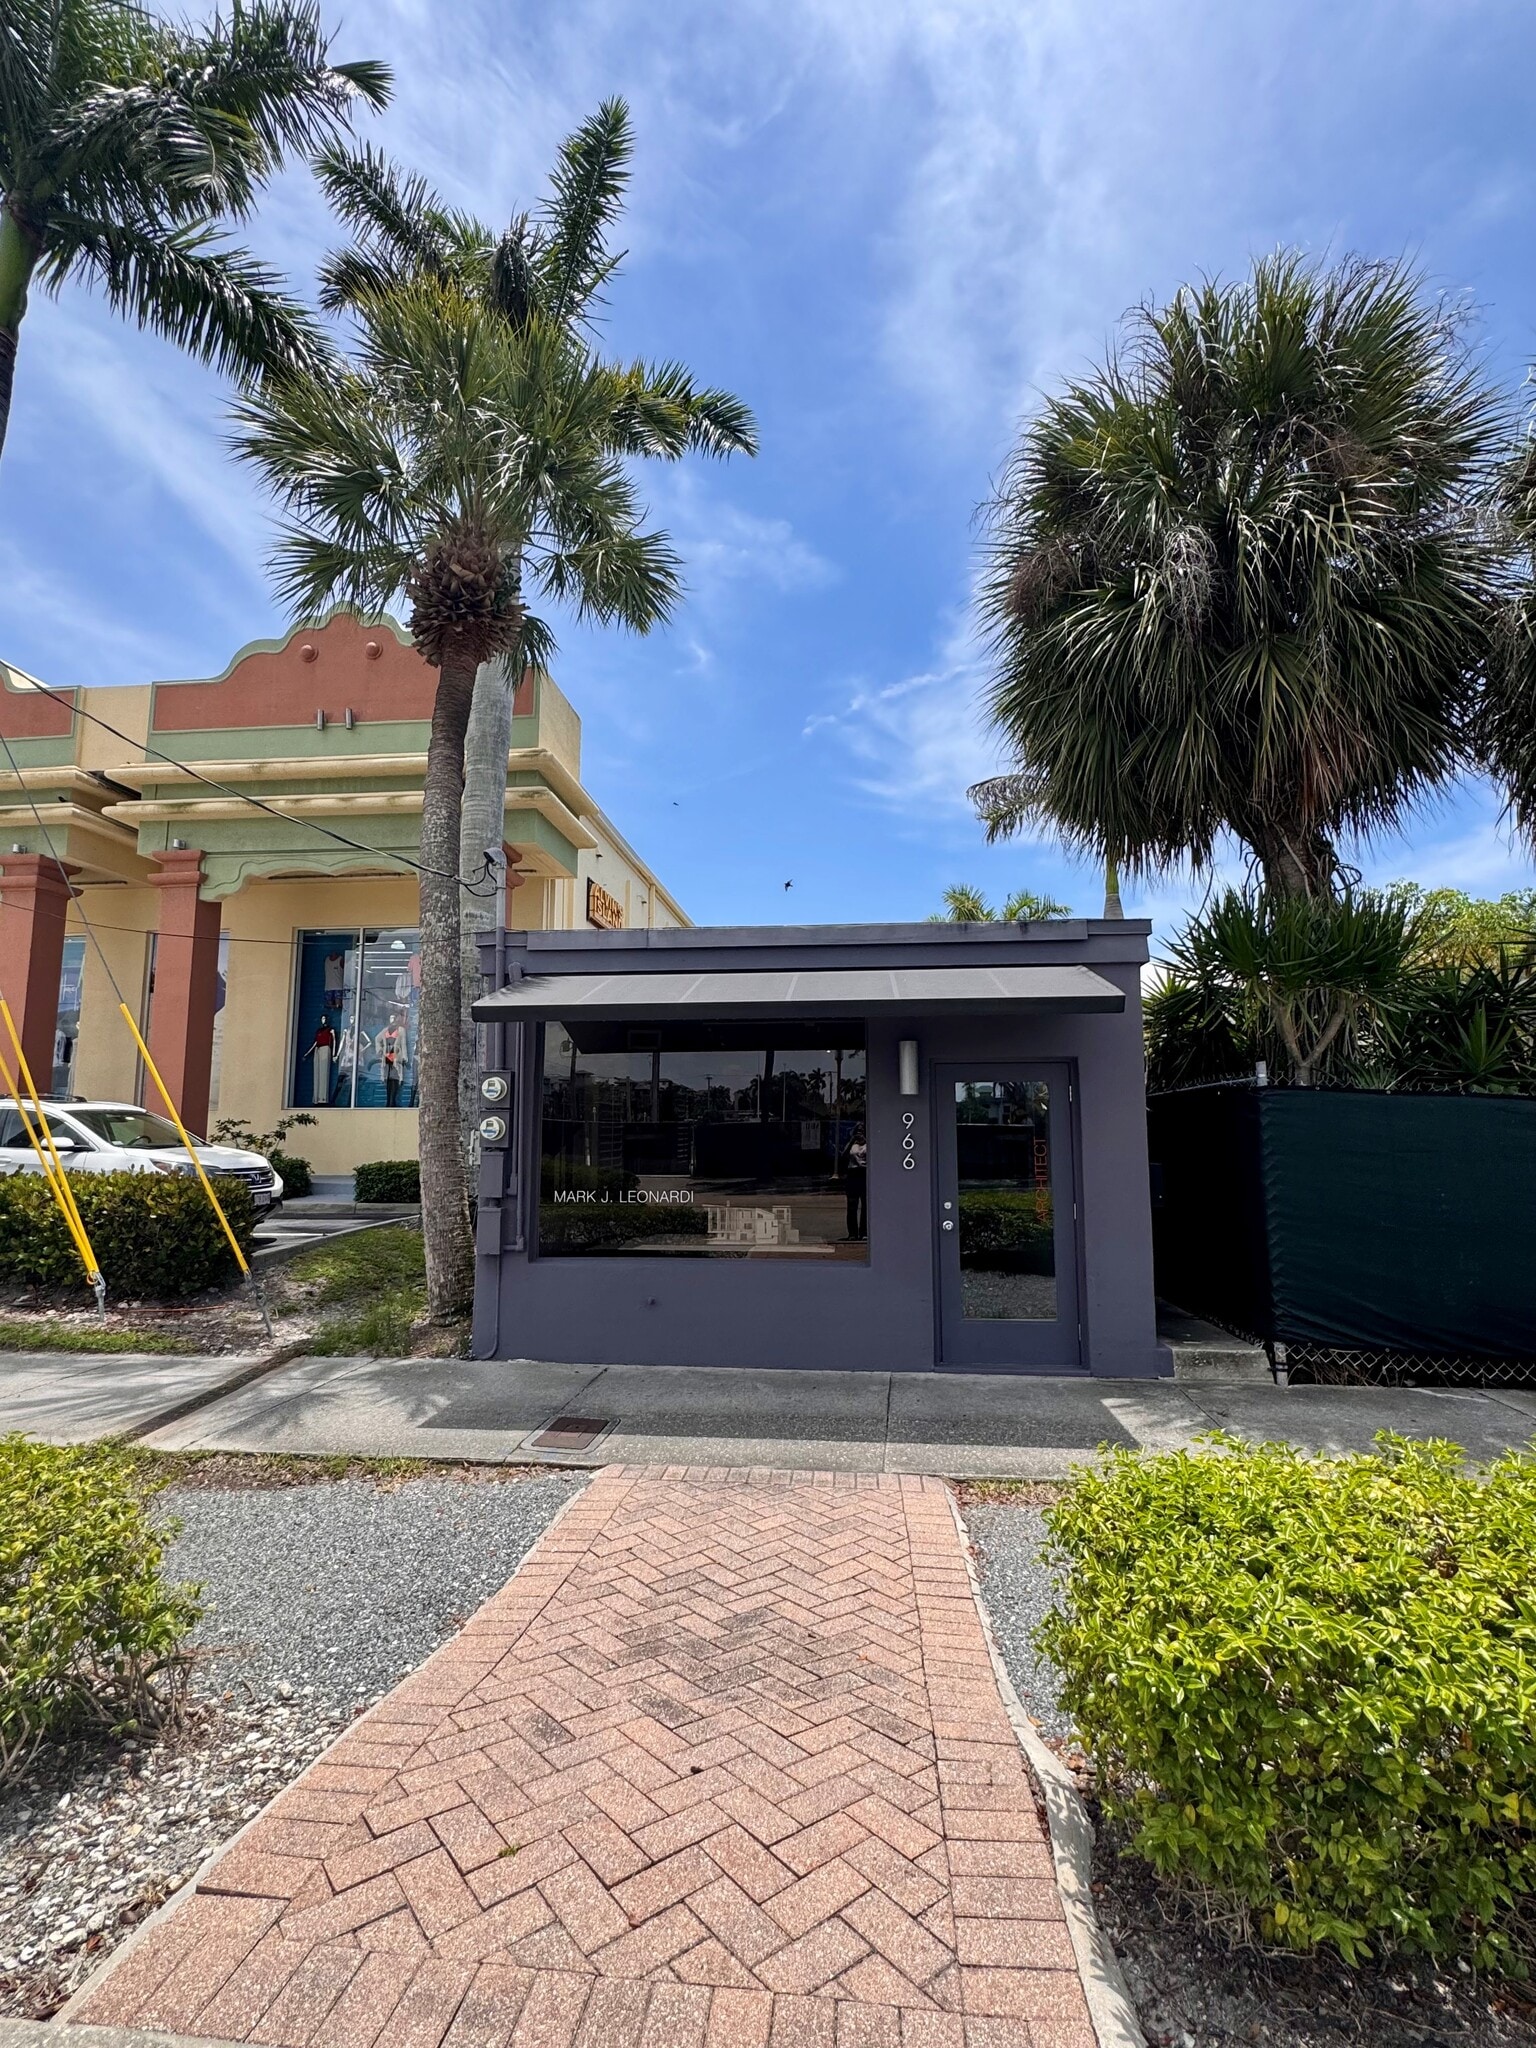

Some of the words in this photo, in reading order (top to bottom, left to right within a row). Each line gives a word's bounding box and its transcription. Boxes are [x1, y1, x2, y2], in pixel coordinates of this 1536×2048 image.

[902, 1112, 915, 1170] 966
[554, 1190, 596, 1203] MARK
[601, 1190, 613, 1203] J.
[619, 1190, 694, 1203] LEONARDI
[1034, 1137, 1049, 1224] ARCHITECT
